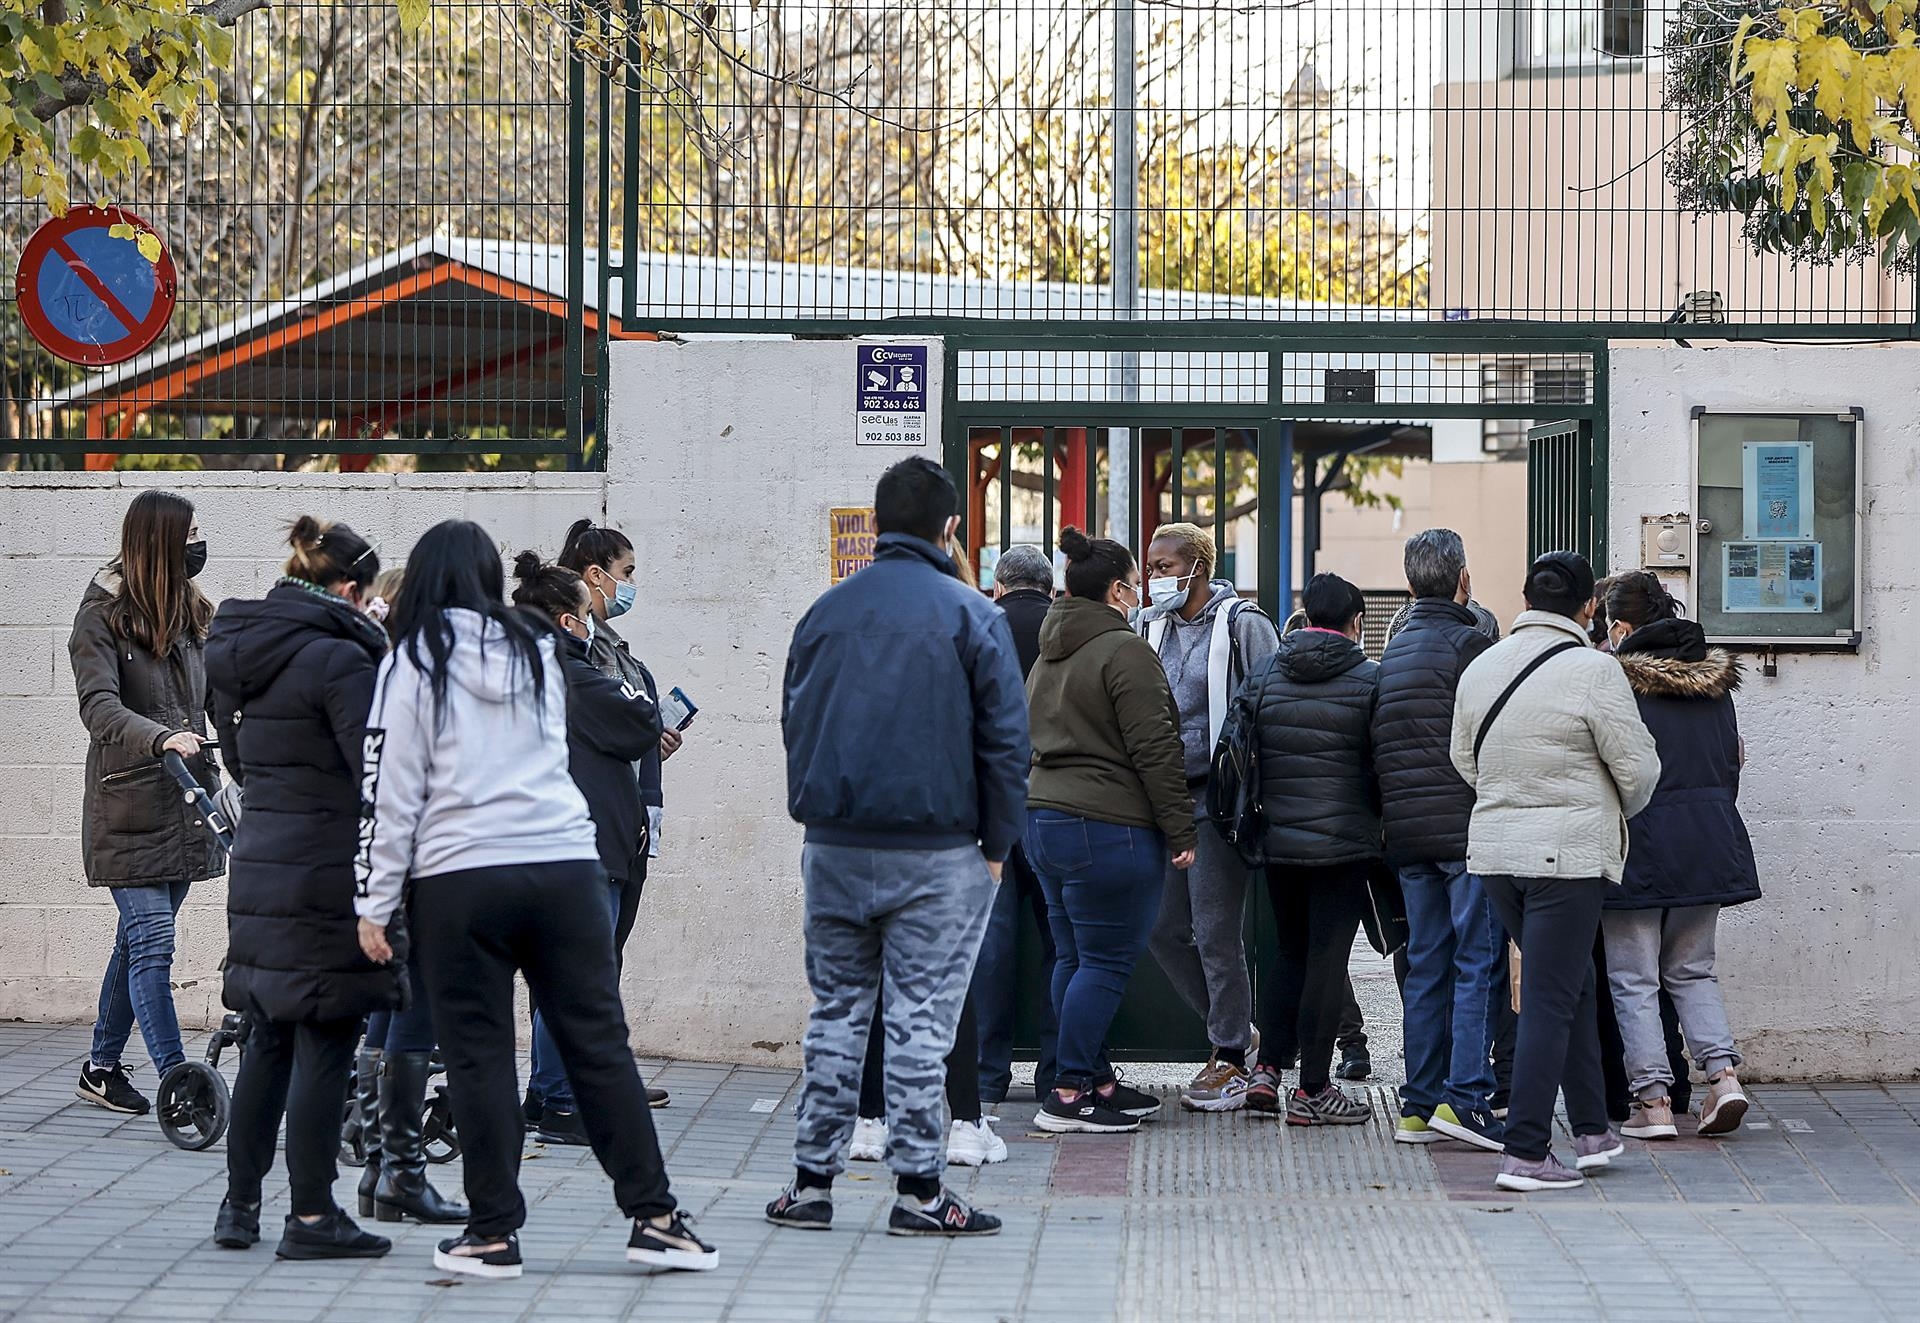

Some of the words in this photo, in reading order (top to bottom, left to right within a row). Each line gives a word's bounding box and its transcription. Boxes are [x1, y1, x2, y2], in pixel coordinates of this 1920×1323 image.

[863, 400, 881, 409] 902
[883, 400, 900, 409] 363
[902, 400, 920, 409] 663
[865, 432, 882, 441] 902
[884, 432, 902, 441] 503
[904, 432, 921, 441] 885
[360, 733, 385, 804] AIR
